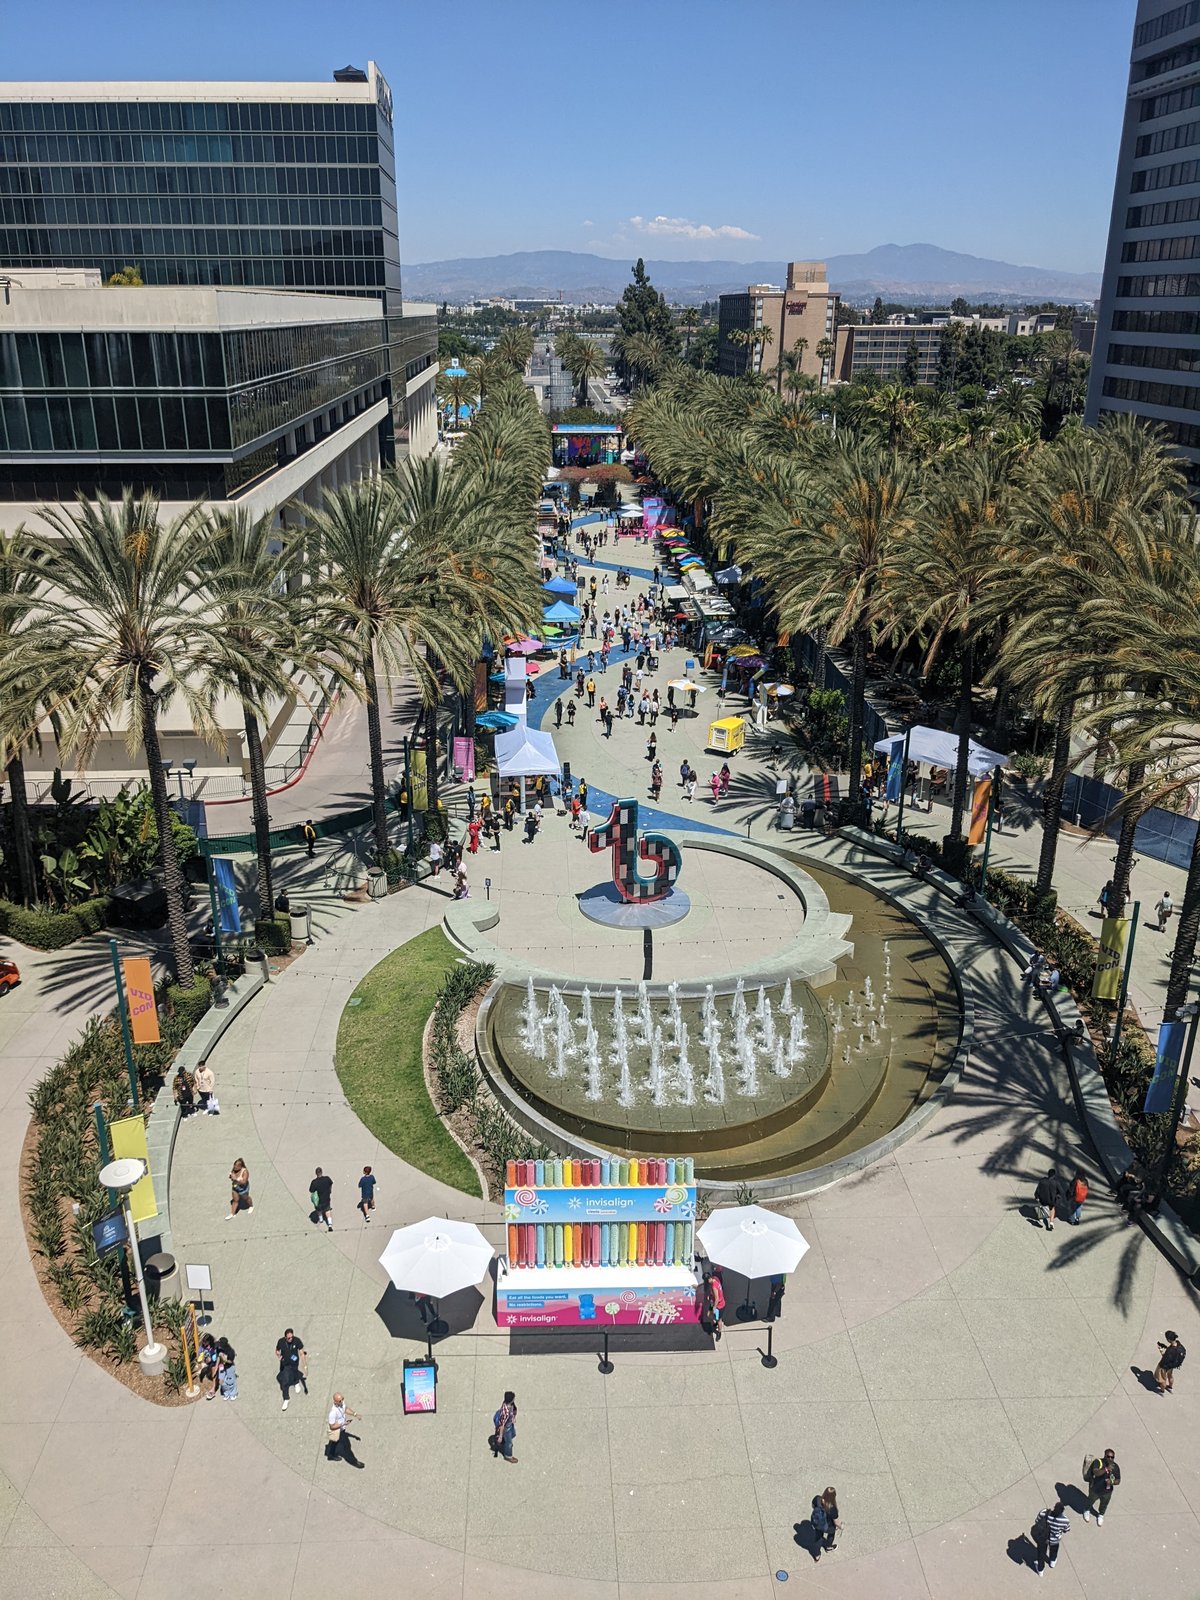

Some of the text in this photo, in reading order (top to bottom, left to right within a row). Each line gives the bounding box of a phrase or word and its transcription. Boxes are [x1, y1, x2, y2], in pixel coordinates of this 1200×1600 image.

[220, 896, 238, 908] CON
[1101, 943, 1121, 960] VID
[1097, 959, 1120, 972] CON
[130, 987, 153, 1001] VID
[132, 1000, 154, 1016] CON
[586, 1197, 634, 1209] invisalign
[519, 1314, 557, 1323] invisalign
